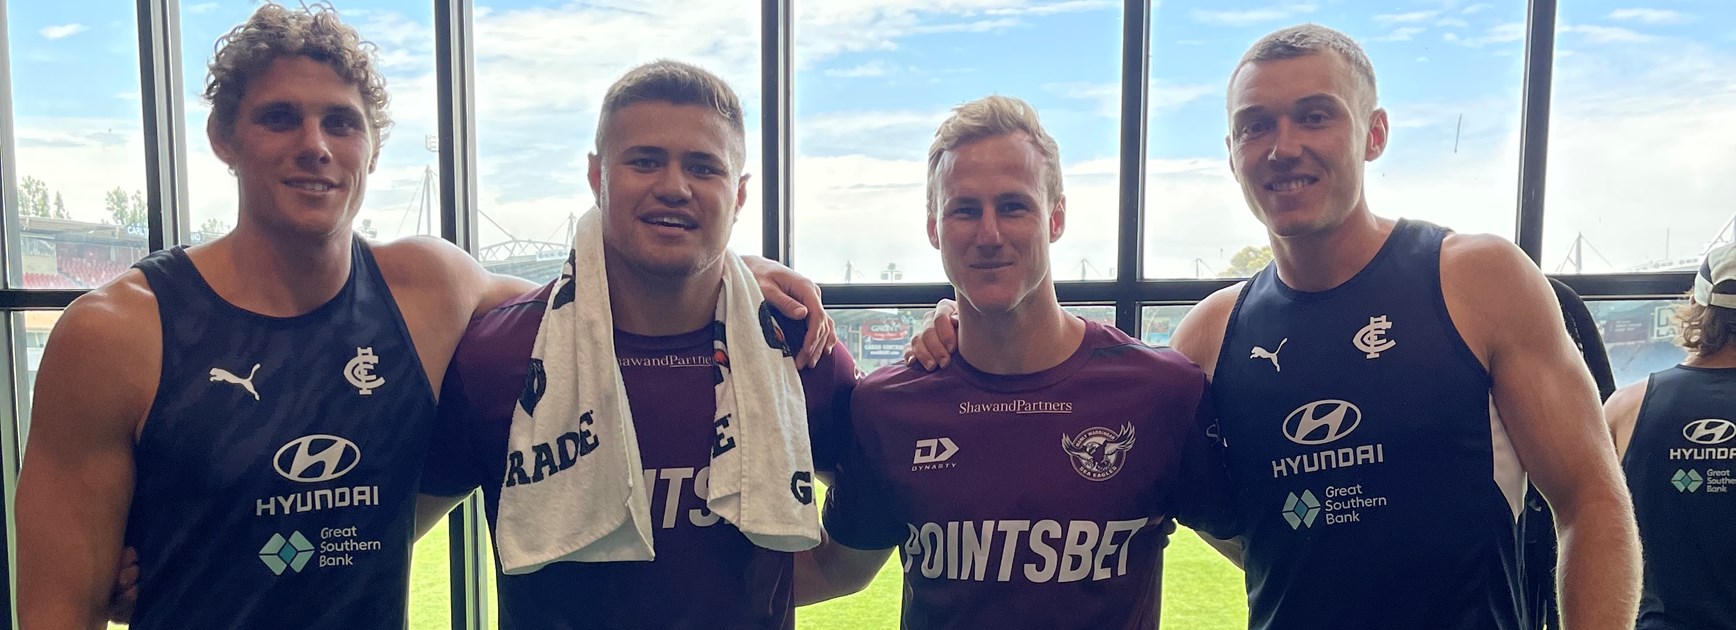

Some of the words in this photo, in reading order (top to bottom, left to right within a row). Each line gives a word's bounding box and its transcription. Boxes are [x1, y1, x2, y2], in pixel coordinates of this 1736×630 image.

[959, 399, 1073, 415] ShawandPartners
[1670, 447, 1736, 460] HYUNDA
[911, 463, 957, 471] DYNASTY
[1272, 444, 1384, 478] HYUNDAI
[1079, 466, 1091, 477] SEA
[1092, 466, 1118, 478] EAGLES
[1707, 468, 1730, 477] Great
[1325, 484, 1363, 498] Great
[1707, 485, 1728, 493] Bank
[256, 486, 379, 516] HYUNDAI
[1325, 496, 1387, 512] Southern
[1326, 511, 1361, 525] Bank
[320, 526, 358, 539] Great
[319, 540, 382, 554] Southern
[319, 554, 354, 568] Bank
